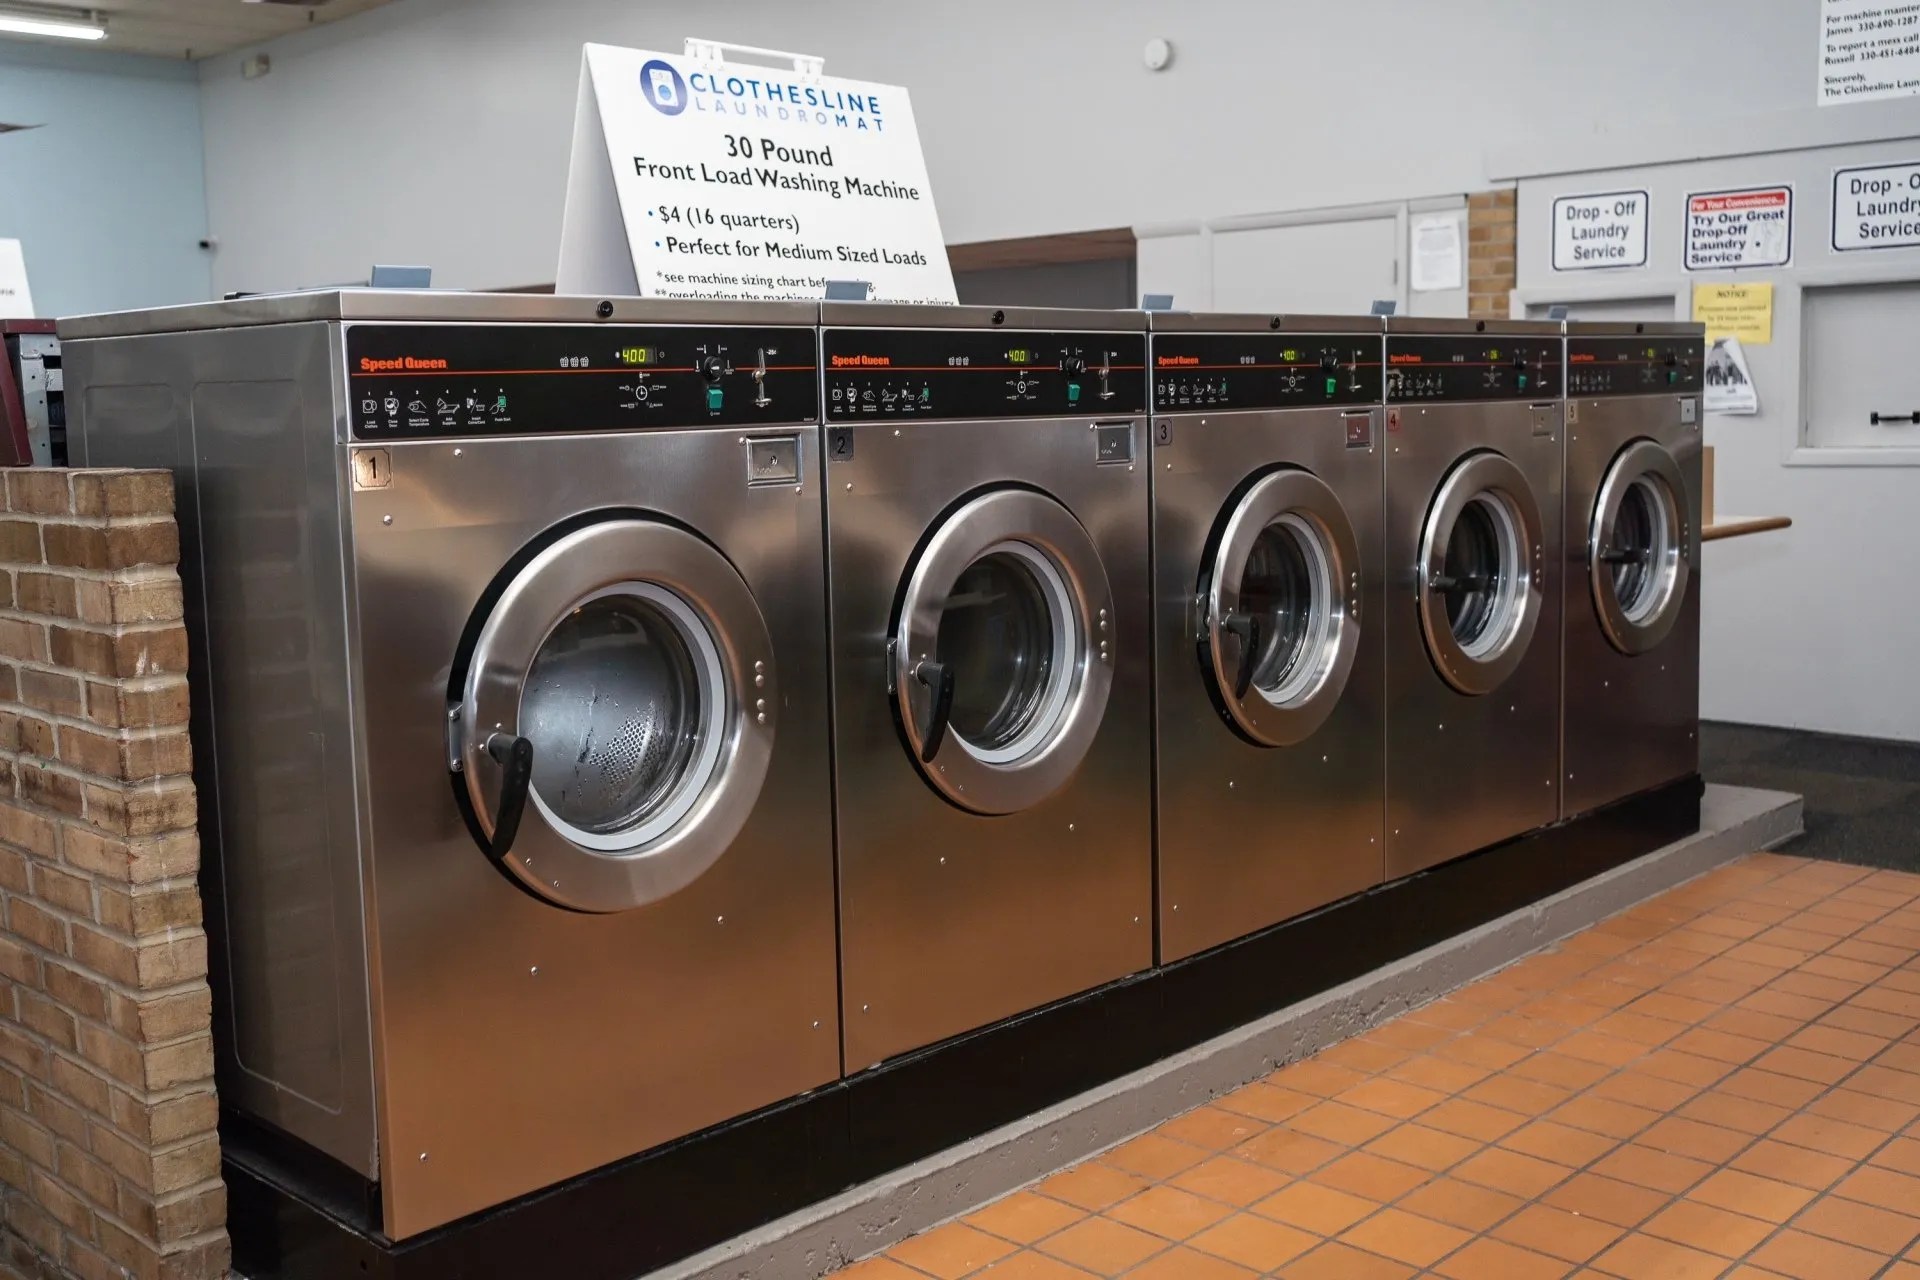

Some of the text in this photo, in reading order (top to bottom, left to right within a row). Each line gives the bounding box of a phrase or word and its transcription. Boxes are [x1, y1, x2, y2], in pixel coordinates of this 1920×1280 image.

[1826, 16, 1840, 24] For
[1844, 9, 1881, 21] machine
[1826, 26, 1853, 38] James
[1826, 44, 1836, 53] To
[1839, 41, 1867, 52] report
[1878, 37, 1900, 46] mess
[1903, 33, 1919, 42] call
[1825, 54, 1855, 65] Russell
[690, 73, 881, 115] CLOTHESLINE
[1824, 88, 1841, 97] The
[1844, 82, 1894, 95] Clothesline
[696, 98, 884, 132] LAUNDROMAT
[724, 134, 834, 167] 30 Pound
[633, 156, 920, 200] Front Load Washing Machine
[1851, 178, 1891, 197] Drop
[1567, 205, 1600, 221] Drop
[1614, 200, 1636, 216] Off
[1693, 209, 1784, 226] Try Our Great
[659, 205, 800, 235] $4 (16 quarters)
[1571, 223, 1629, 241] Laundry
[1692, 225, 1748, 238] Drop-Off
[1859, 219, 1920, 239] Service
[666, 236, 927, 266] Perfect for Medium Sized Loads
[1574, 245, 1625, 260] Service
[1692, 238, 1746, 251] Laundry
[1691, 253, 1742, 264] Service
[688, 273, 739, 285] machine
[741, 274, 774, 289] sizing
[776, 276, 806, 287] chart
[622, 349, 646, 362] 400
[832, 355, 890, 367] Speed Queen
[1008, 350, 1025, 361] 400
[1159, 356, 1199, 366] Speed Queen
[361, 357, 447, 372] Speed Queen
[1570, 405, 1574, 419] 5
[1390, 413, 1396, 428] 4
[1160, 424, 1167, 440] 3
[837, 436, 846, 454] 2
[369, 456, 377, 479] 1
